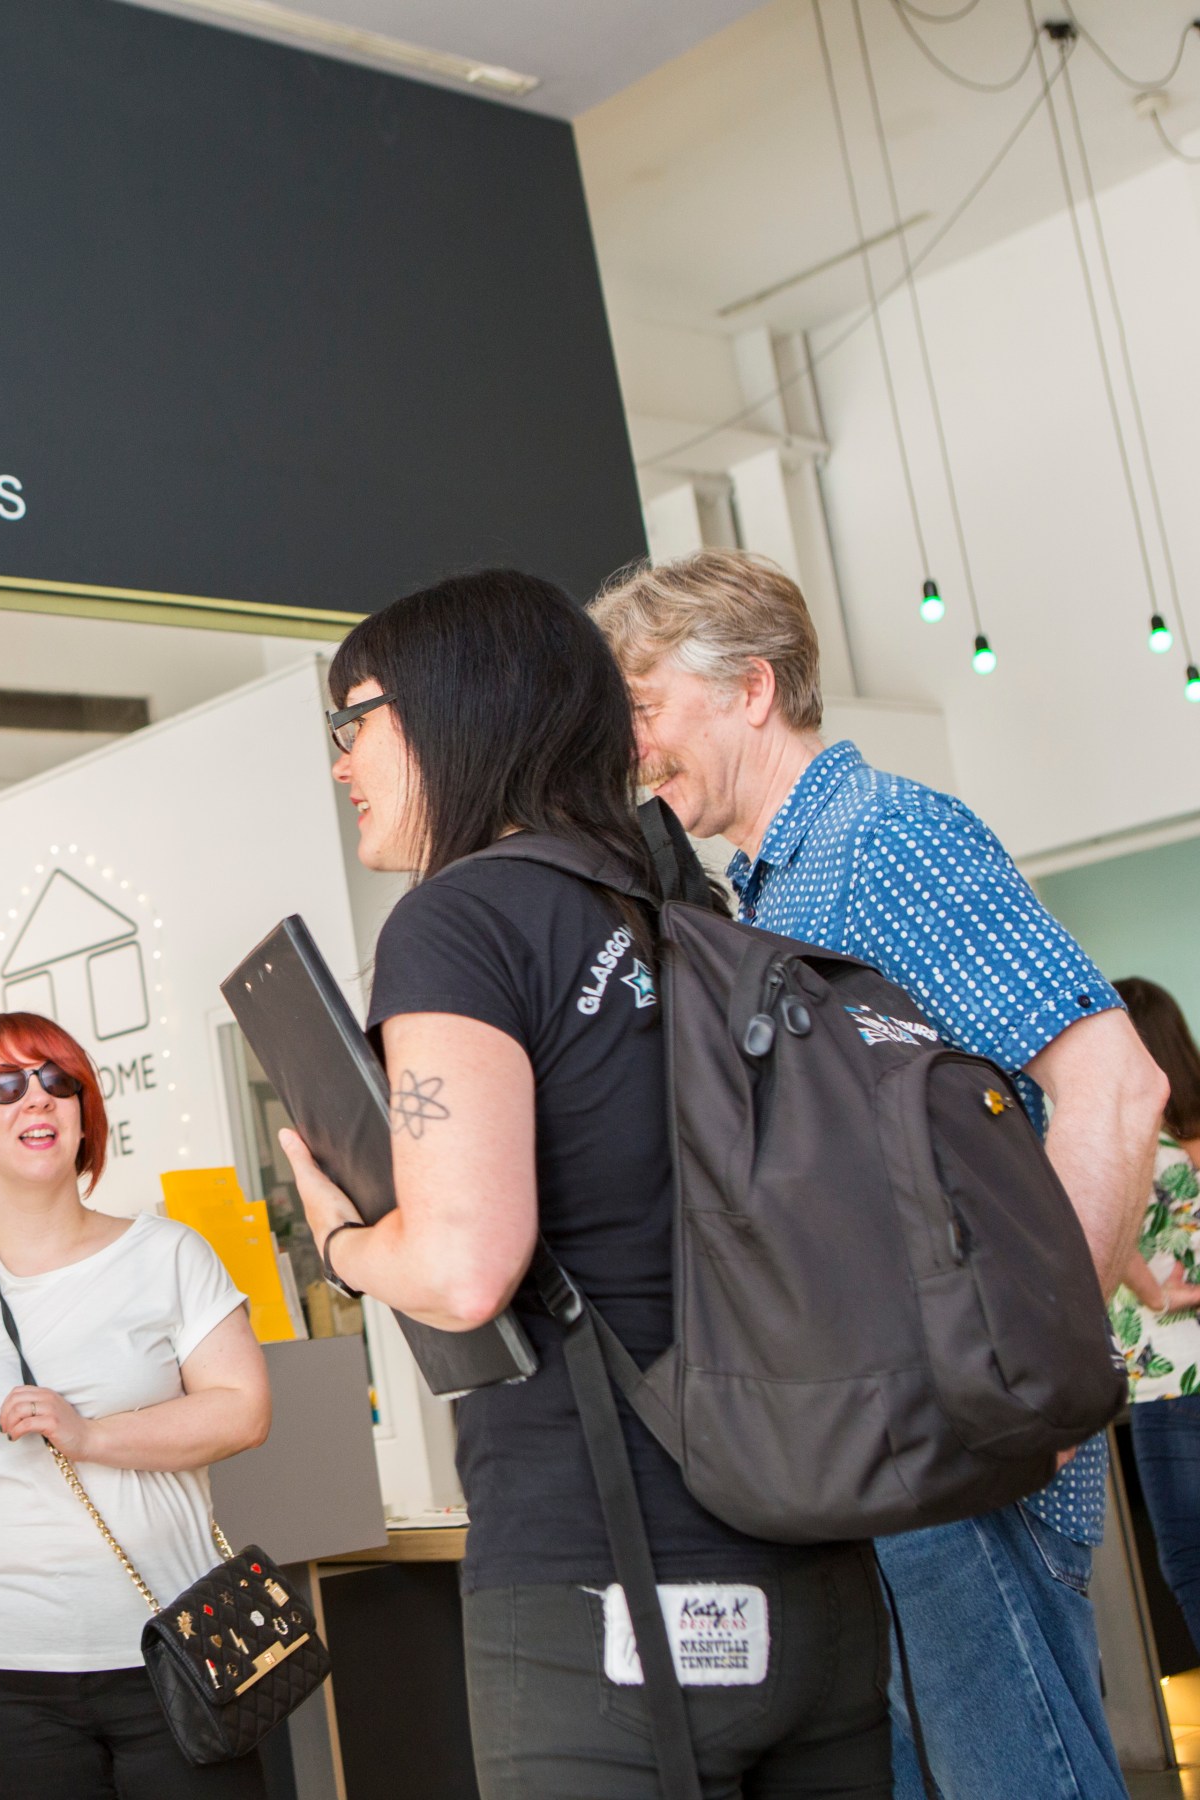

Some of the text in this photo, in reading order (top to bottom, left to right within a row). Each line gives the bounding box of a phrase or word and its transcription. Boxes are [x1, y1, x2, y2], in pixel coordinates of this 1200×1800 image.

[576, 925, 636, 1015] GLASGO
[680, 1597, 749, 1629] Katy K
[679, 1639, 749, 1654] NASHVILLE
[679, 1655, 749, 1670] TENNESSEE
